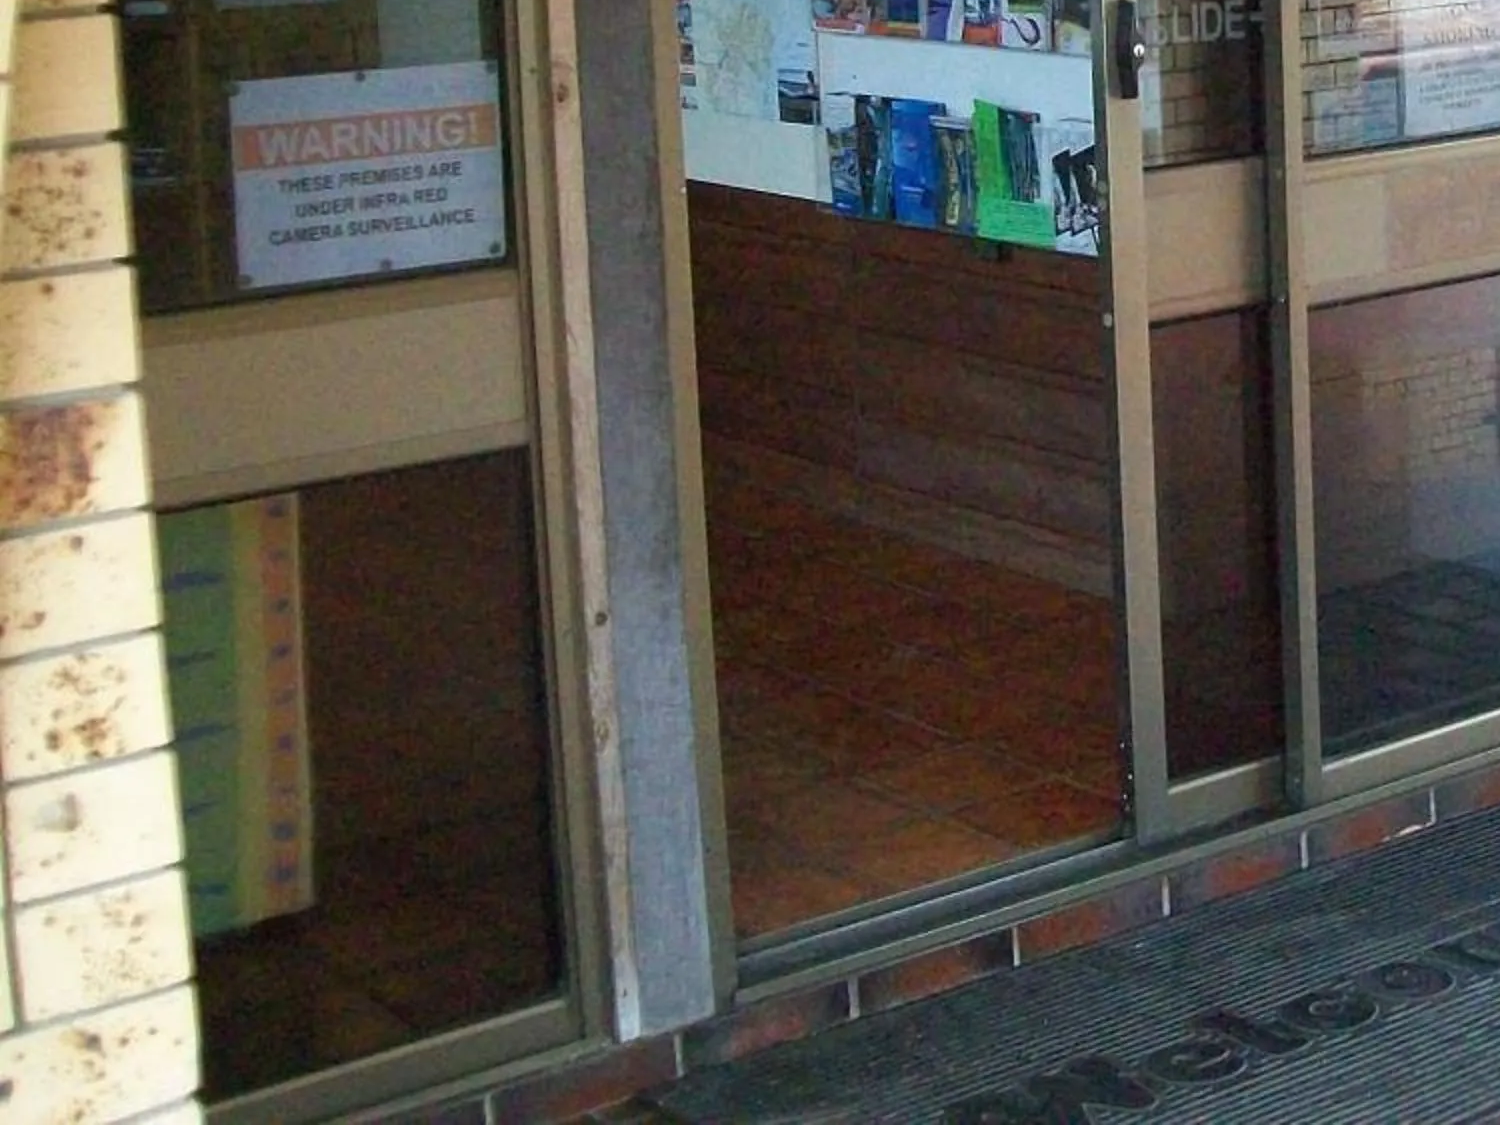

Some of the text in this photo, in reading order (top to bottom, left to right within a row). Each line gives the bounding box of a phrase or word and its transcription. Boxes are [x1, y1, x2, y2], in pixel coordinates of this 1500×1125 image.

[258, 110, 480, 165] WARNING!
[277, 161, 463, 193] THESE PREMISES ARE
[294, 186, 448, 218] UNDER INFRA RED
[268, 208, 475, 246] CAMERA SURVEILLANCE
